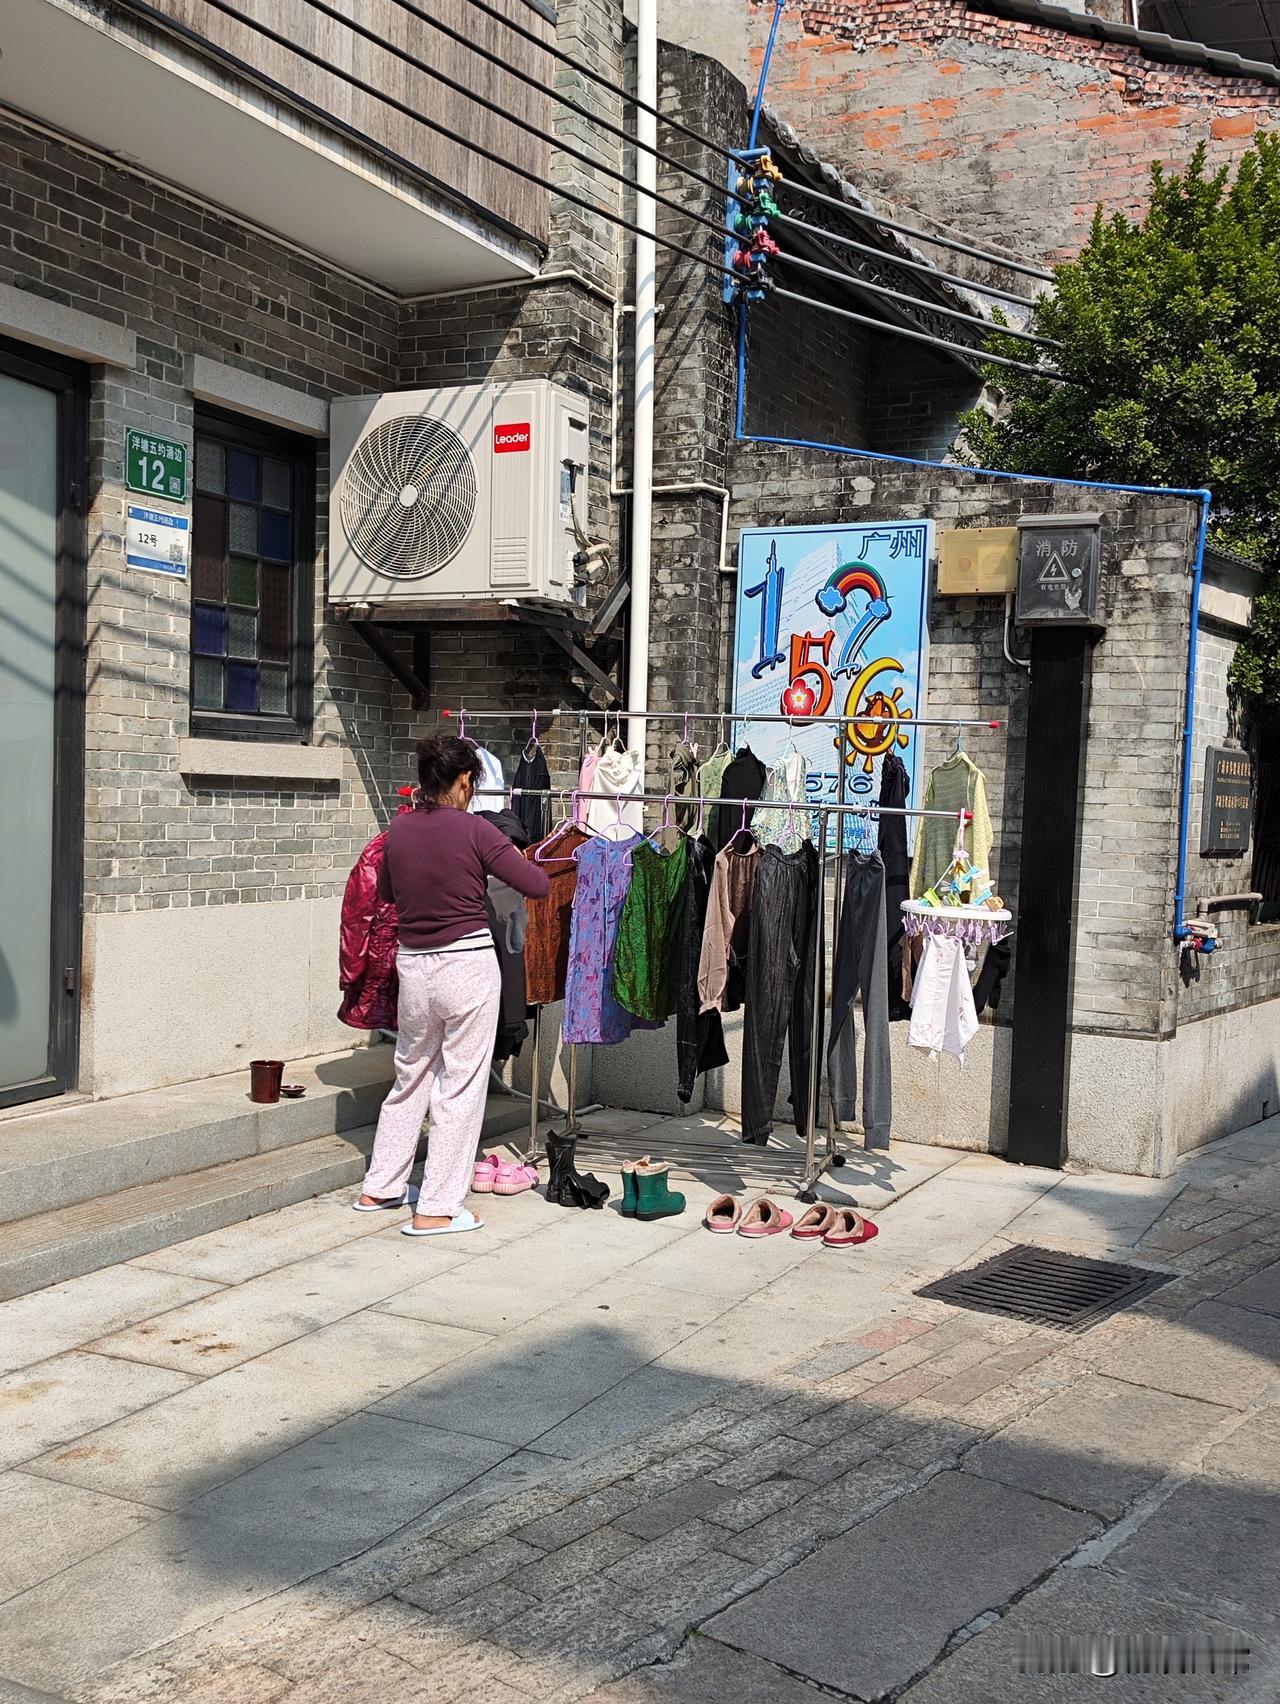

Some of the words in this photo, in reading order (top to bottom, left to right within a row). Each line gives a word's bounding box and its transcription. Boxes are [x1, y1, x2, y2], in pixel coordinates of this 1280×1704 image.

[495, 432, 529, 445] Leader
[138, 456, 165, 491] 12
[138, 532, 158, 548] 12号
[857, 530, 923, 560] 广州
[1035, 539, 1078, 558] 消防
